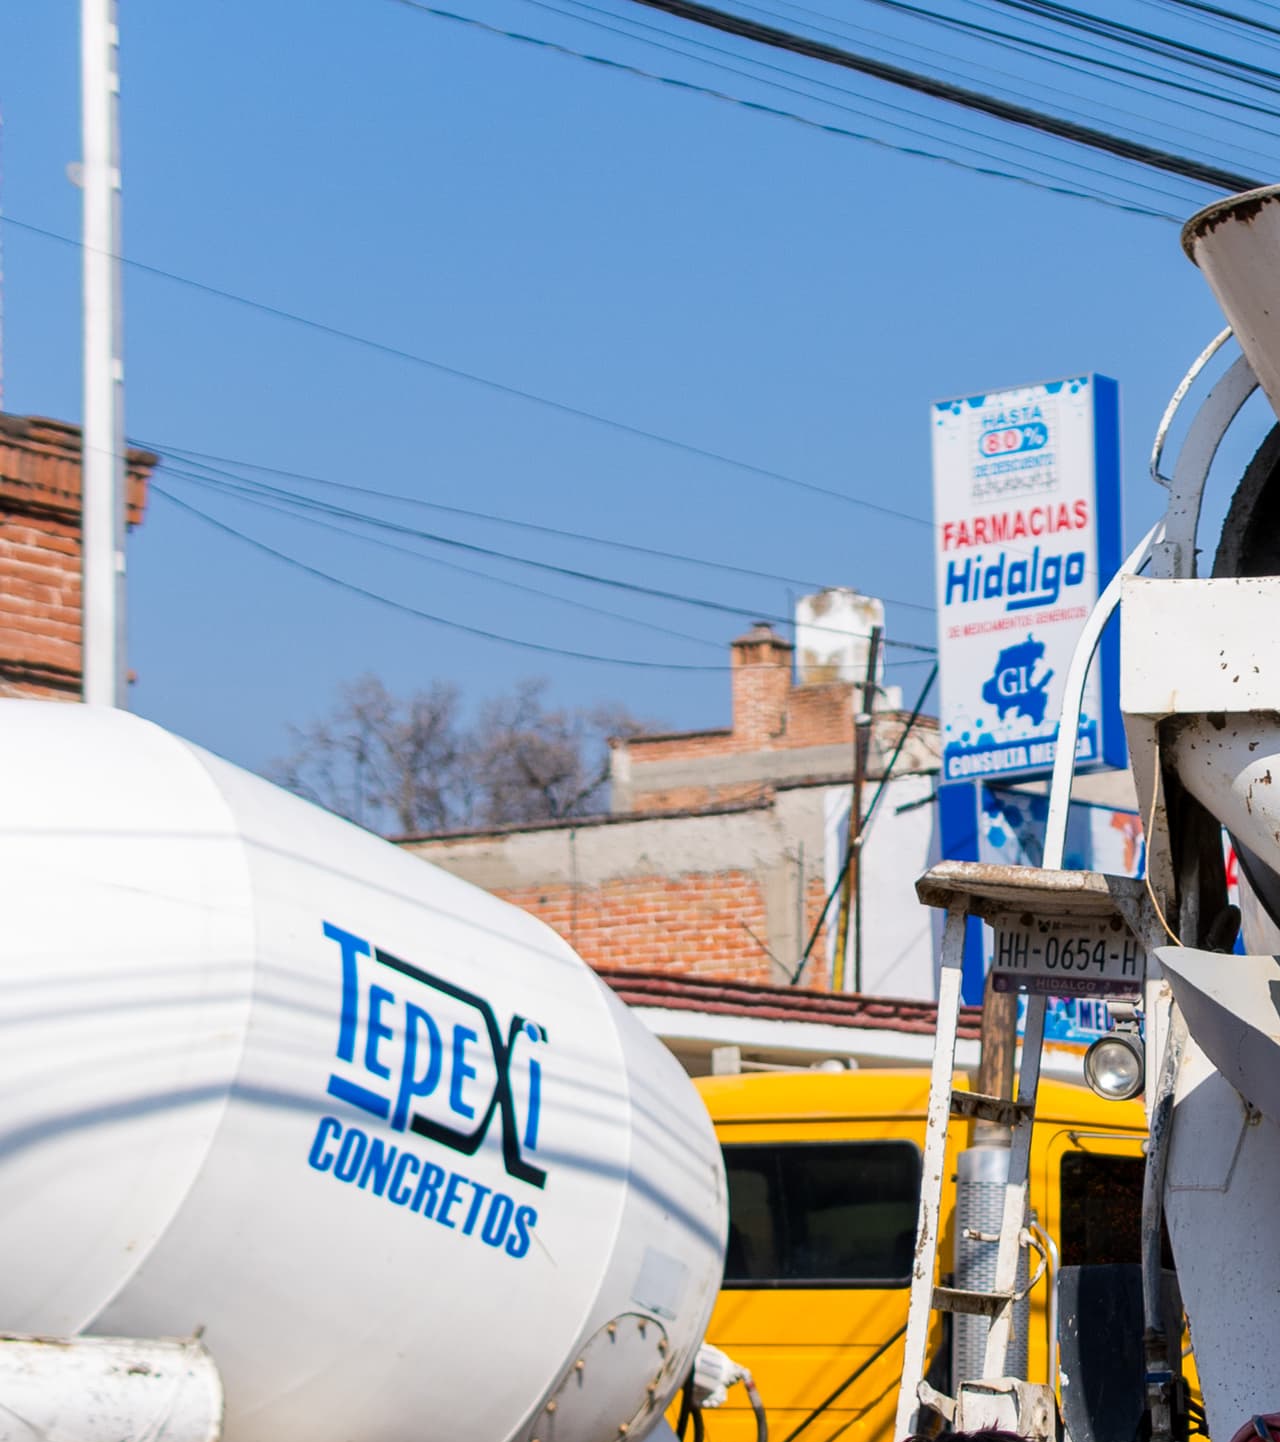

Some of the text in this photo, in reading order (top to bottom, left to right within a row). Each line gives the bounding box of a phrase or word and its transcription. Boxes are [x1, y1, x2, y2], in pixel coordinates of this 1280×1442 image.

[981, 405, 1043, 427] HASTA
[986, 425, 1046, 452] 80%
[942, 500, 1088, 551] FARMACIAS
[945, 545, 1086, 611] Hidalgo
[998, 666, 1028, 696] GI
[949, 747, 1029, 777] CONSULTA
[998, 931, 1138, 976] HH-0654-H
[1036, 978, 1097, 992] HIDALGO
[307, 1116, 538, 1260] CONCRETOS
